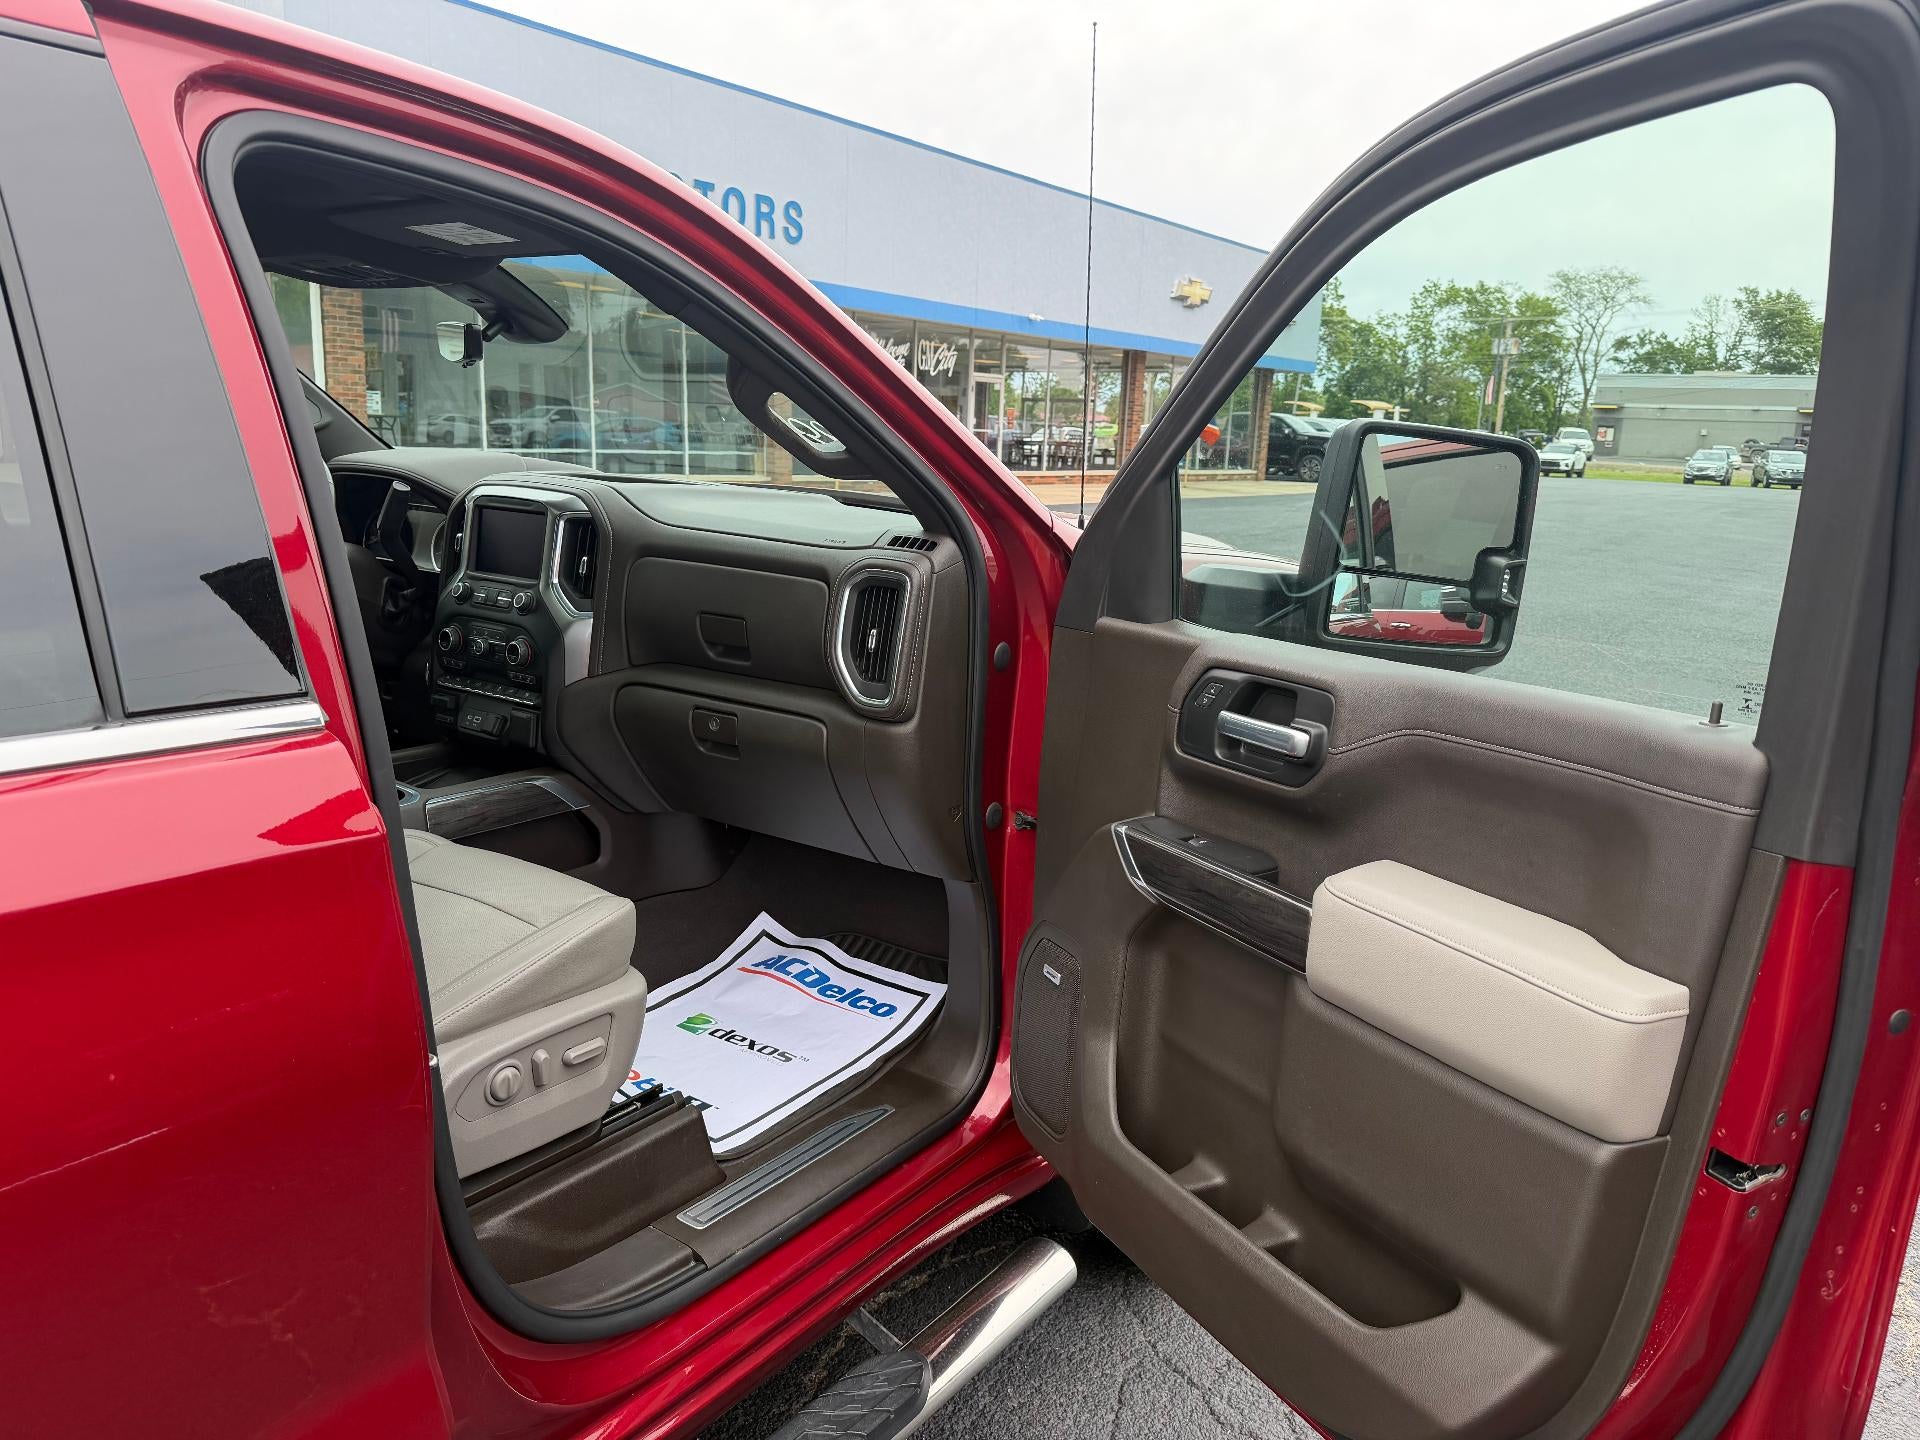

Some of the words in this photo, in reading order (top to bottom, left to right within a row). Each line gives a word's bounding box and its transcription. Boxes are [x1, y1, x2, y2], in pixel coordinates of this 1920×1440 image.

[670, 172, 803, 245] TORS
[751, 954, 898, 1018] ACDelco
[708, 1028, 798, 1063] dexos
